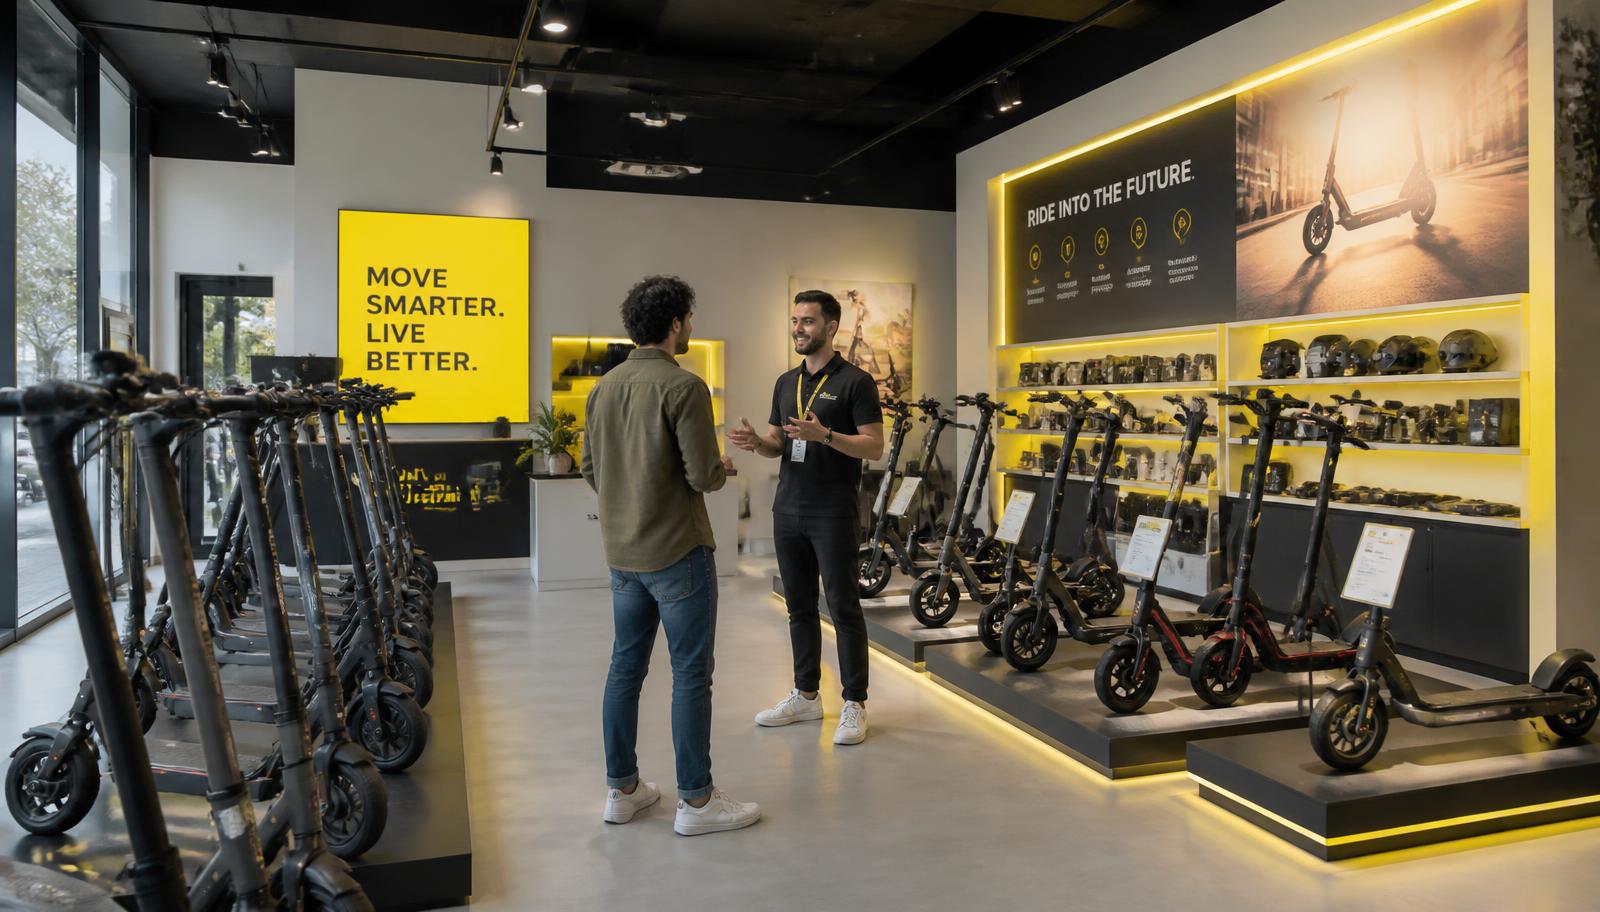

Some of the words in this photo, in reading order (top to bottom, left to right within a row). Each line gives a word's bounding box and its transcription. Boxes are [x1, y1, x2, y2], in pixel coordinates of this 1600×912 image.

[1027, 202, 1056, 228] RIDE
[1058, 192, 1090, 219] INTO
[1093, 181, 1122, 208] THE
[1126, 159, 1195, 199] FUTURE.
[367, 266, 447, 288] MOVE
[366, 294, 504, 317] SMARTER.
[367, 323, 425, 343] LIVE
[366, 351, 478, 371] BETTER.
